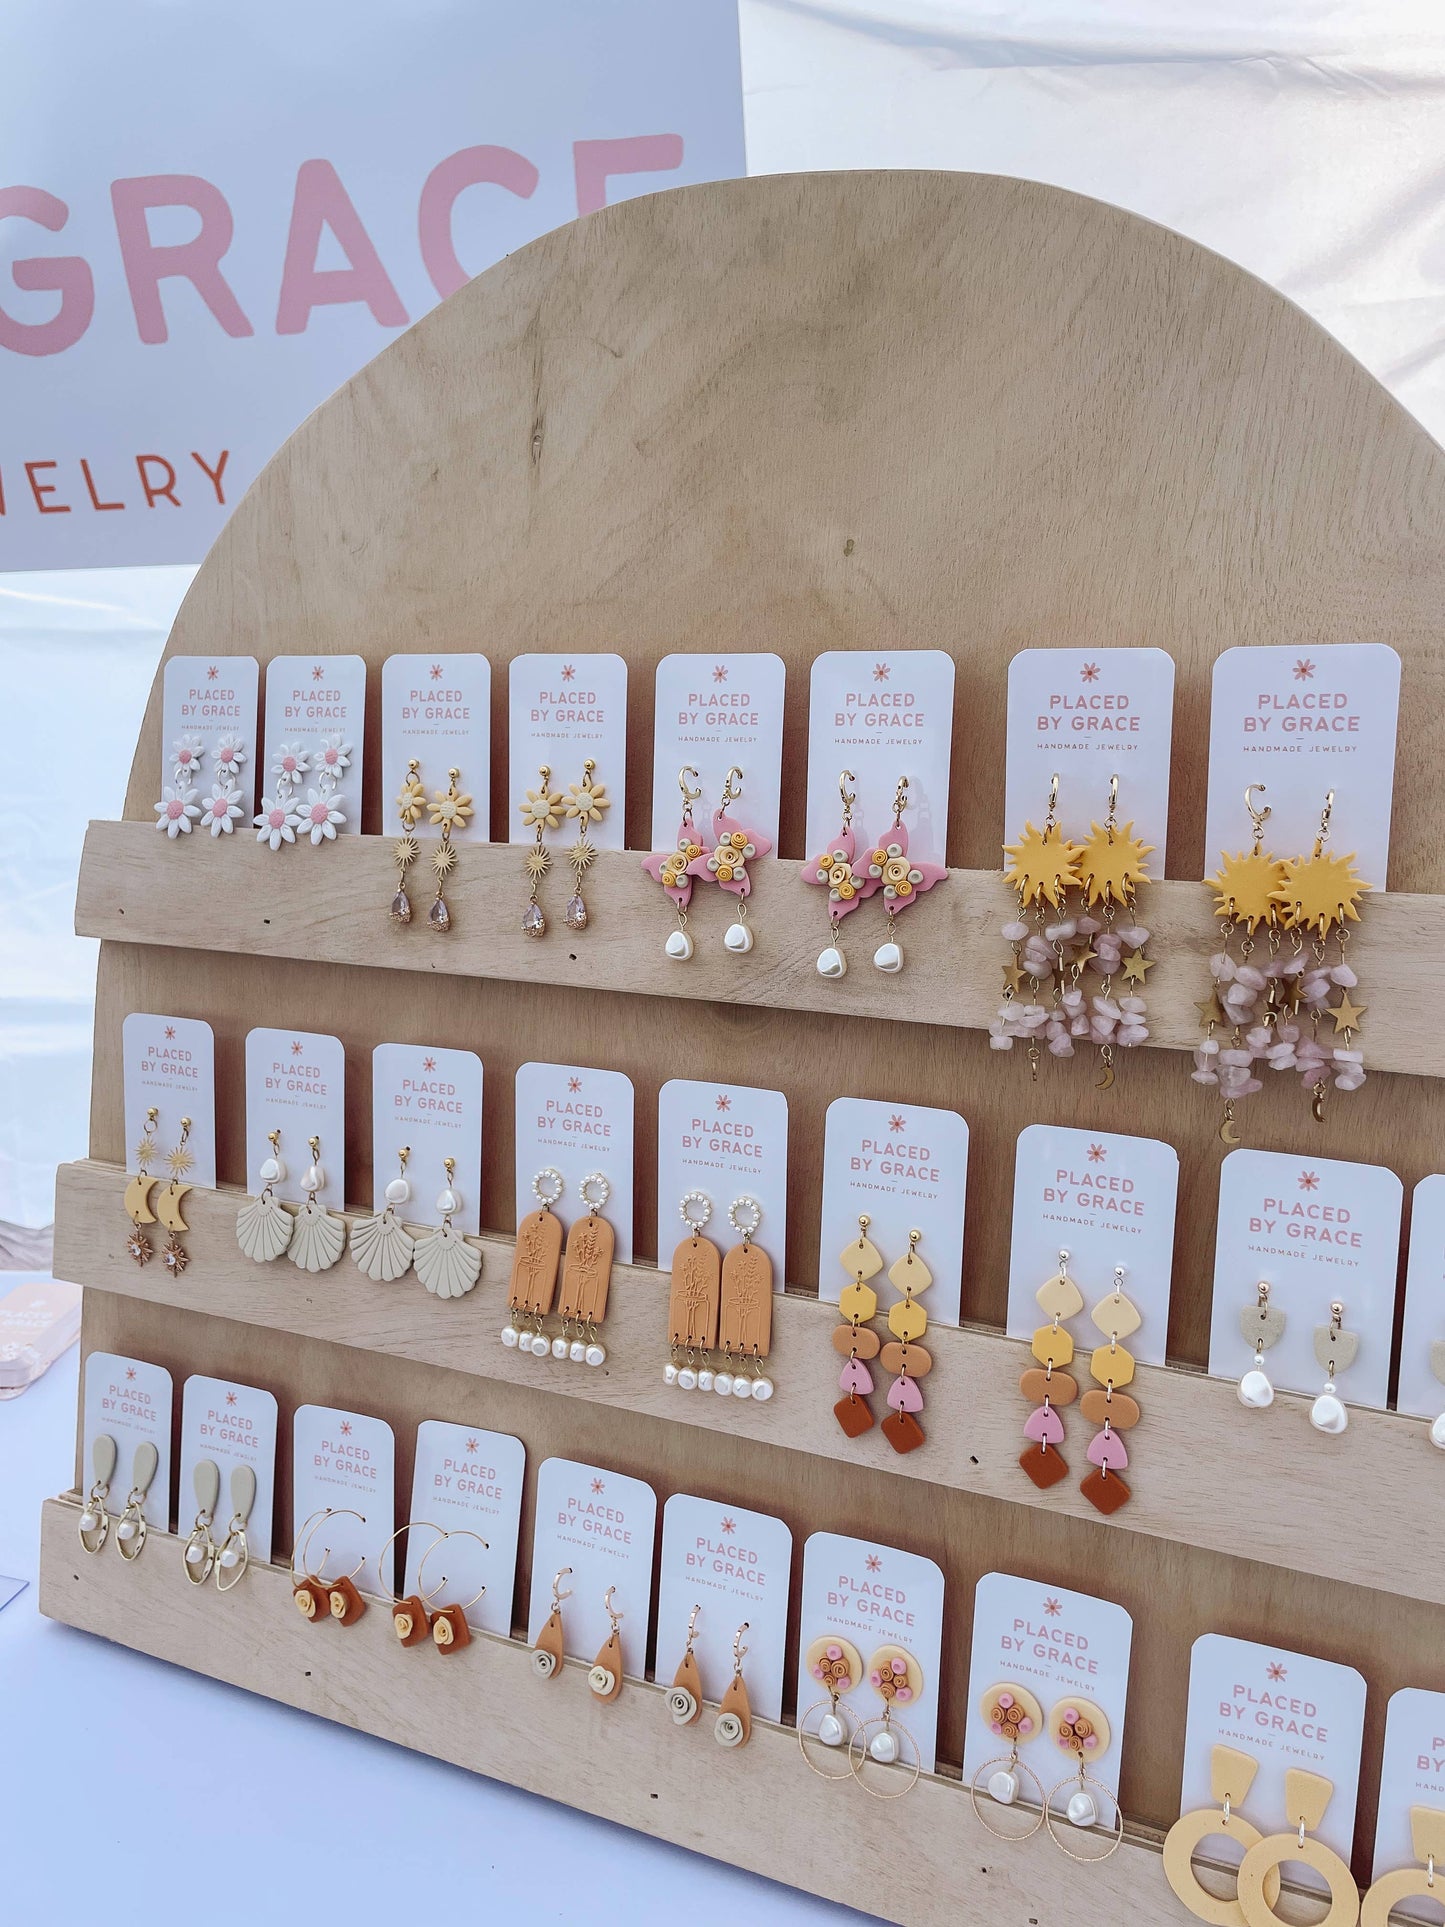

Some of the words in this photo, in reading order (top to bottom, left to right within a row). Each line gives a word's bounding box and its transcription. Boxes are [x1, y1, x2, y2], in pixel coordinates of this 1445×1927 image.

[0, 449, 229, 516] ELRY
[189, 689, 235, 701] PLACED
[293, 690, 341, 702] PLACED
[410, 690, 462, 702] PLACED
[540, 691, 596, 704] PLACED
[688, 693, 750, 706] PLACED
[846, 693, 915, 707] PLACED
[1050, 695, 1129, 710] PLACED
[1258, 693, 1347, 710] PLACED
[182, 704, 197, 716] BY
[202, 705, 240, 717] GRACE
[285, 706, 301, 718] BY
[306, 706, 347, 718] GRACE
[402, 707, 419, 719] BY
[425, 707, 470, 719] GRACE
[531, 709, 549, 722] BY
[556, 709, 604, 723] GRACE
[678, 712, 699, 725] BY
[706, 712, 758, 726] GRACE
[835, 713, 856, 726] BY
[864, 713, 924, 727] GRACE
[1037, 716, 1062, 730] BY
[1071, 716, 1140, 732] GRACE
[1244, 717, 1272, 732] BY
[1282, 716, 1359, 732] GRACE
[1096, 743, 1138, 751] JEWELRY
[1243, 745, 1302, 753] HANDMADE
[1308, 745, 1357, 753] JEWELRY
[148, 1046, 192, 1062] PLACED
[141, 1060, 156, 1072] BY
[161, 1062, 198, 1078] GRACE
[273, 1062, 320, 1078] PLACED
[266, 1077, 281, 1089] BY
[287, 1080, 327, 1096] GRACE
[402, 1079, 455, 1096] PLACED
[394, 1094, 412, 1107] BY
[418, 1097, 463, 1114] GRACE
[546, 1100, 603, 1118] PLACED
[394, 1116, 431, 1125] HANDMADE
[538, 1116, 556, 1129] BY
[562, 1119, 611, 1137] GRACE
[692, 1118, 754, 1138] PLACED
[537, 1138, 576, 1148] HANDMADE
[682, 1135, 702, 1149] BY
[709, 1138, 762, 1158] GRACE
[862, 1139, 930, 1161] PLACED
[682, 1158, 724, 1169] HANDMADE
[728, 1164, 761, 1174] JEWELRY
[850, 1157, 872, 1172] BY
[880, 1161, 940, 1182] GRACE
[850, 1180, 896, 1193] HANDMADE
[901, 1188, 938, 1199] JEWELRY
[1056, 1169, 1134, 1193] PLACED
[1044, 1188, 1068, 1204] BY
[1077, 1192, 1144, 1216] GRACE
[1264, 1198, 1350, 1224] PLACED
[1042, 1213, 1094, 1227] HANDMADE
[1100, 1222, 1142, 1234] JEWELRY
[1249, 1217, 1276, 1234] BY
[1286, 1223, 1362, 1248] GRACE
[1248, 1245, 1305, 1259] HANDMADE
[1312, 1254, 1359, 1267] JEWELRY
[109, 1385, 151, 1405] PLACED
[102, 1398, 116, 1410] BY
[121, 1403, 156, 1422] GRACE
[208, 1410, 252, 1430] PLACED
[200, 1424, 216, 1436] BY
[220, 1429, 258, 1448] GRACE
[322, 1441, 370, 1461] PLACED
[314, 1454, 330, 1468] BY
[336, 1460, 376, 1479] GRACE
[444, 1458, 496, 1480] PLACED
[434, 1474, 452, 1488] BY
[457, 1479, 502, 1500] GRACE
[432, 1496, 469, 1508] HANDMADE
[568, 1497, 624, 1524] PLACED
[558, 1512, 576, 1527] BY
[582, 1519, 632, 1544] GRACE
[556, 1534, 596, 1549] HANDMADE
[696, 1537, 758, 1564] PLACED
[686, 1552, 706, 1568] BY
[712, 1560, 766, 1586] GRACE
[685, 1575, 727, 1591] HANDMADE
[730, 1587, 764, 1601] JEWELRY
[838, 1575, 906, 1604] PLACED
[828, 1592, 849, 1608] BY
[857, 1599, 915, 1627] GRACE
[826, 1615, 872, 1632] HANDMADE
[877, 1628, 913, 1644] JEWELRY
[1014, 1618, 1088, 1650] PLACED
[1001, 1635, 1024, 1652] BY
[1033, 1644, 1098, 1675] GRACE
[999, 1660, 1050, 1678] HANDMADE
[1055, 1675, 1095, 1692] JEWELRY
[1233, 1684, 1316, 1718] PLACED
[1220, 1702, 1246, 1720] BY
[1255, 1711, 1328, 1743] GRACE
[1218, 1727, 1273, 1748] HANDMADE
[1280, 1745, 1325, 1761] JEWELRY
[1417, 1755, 1445, 1772] BY
